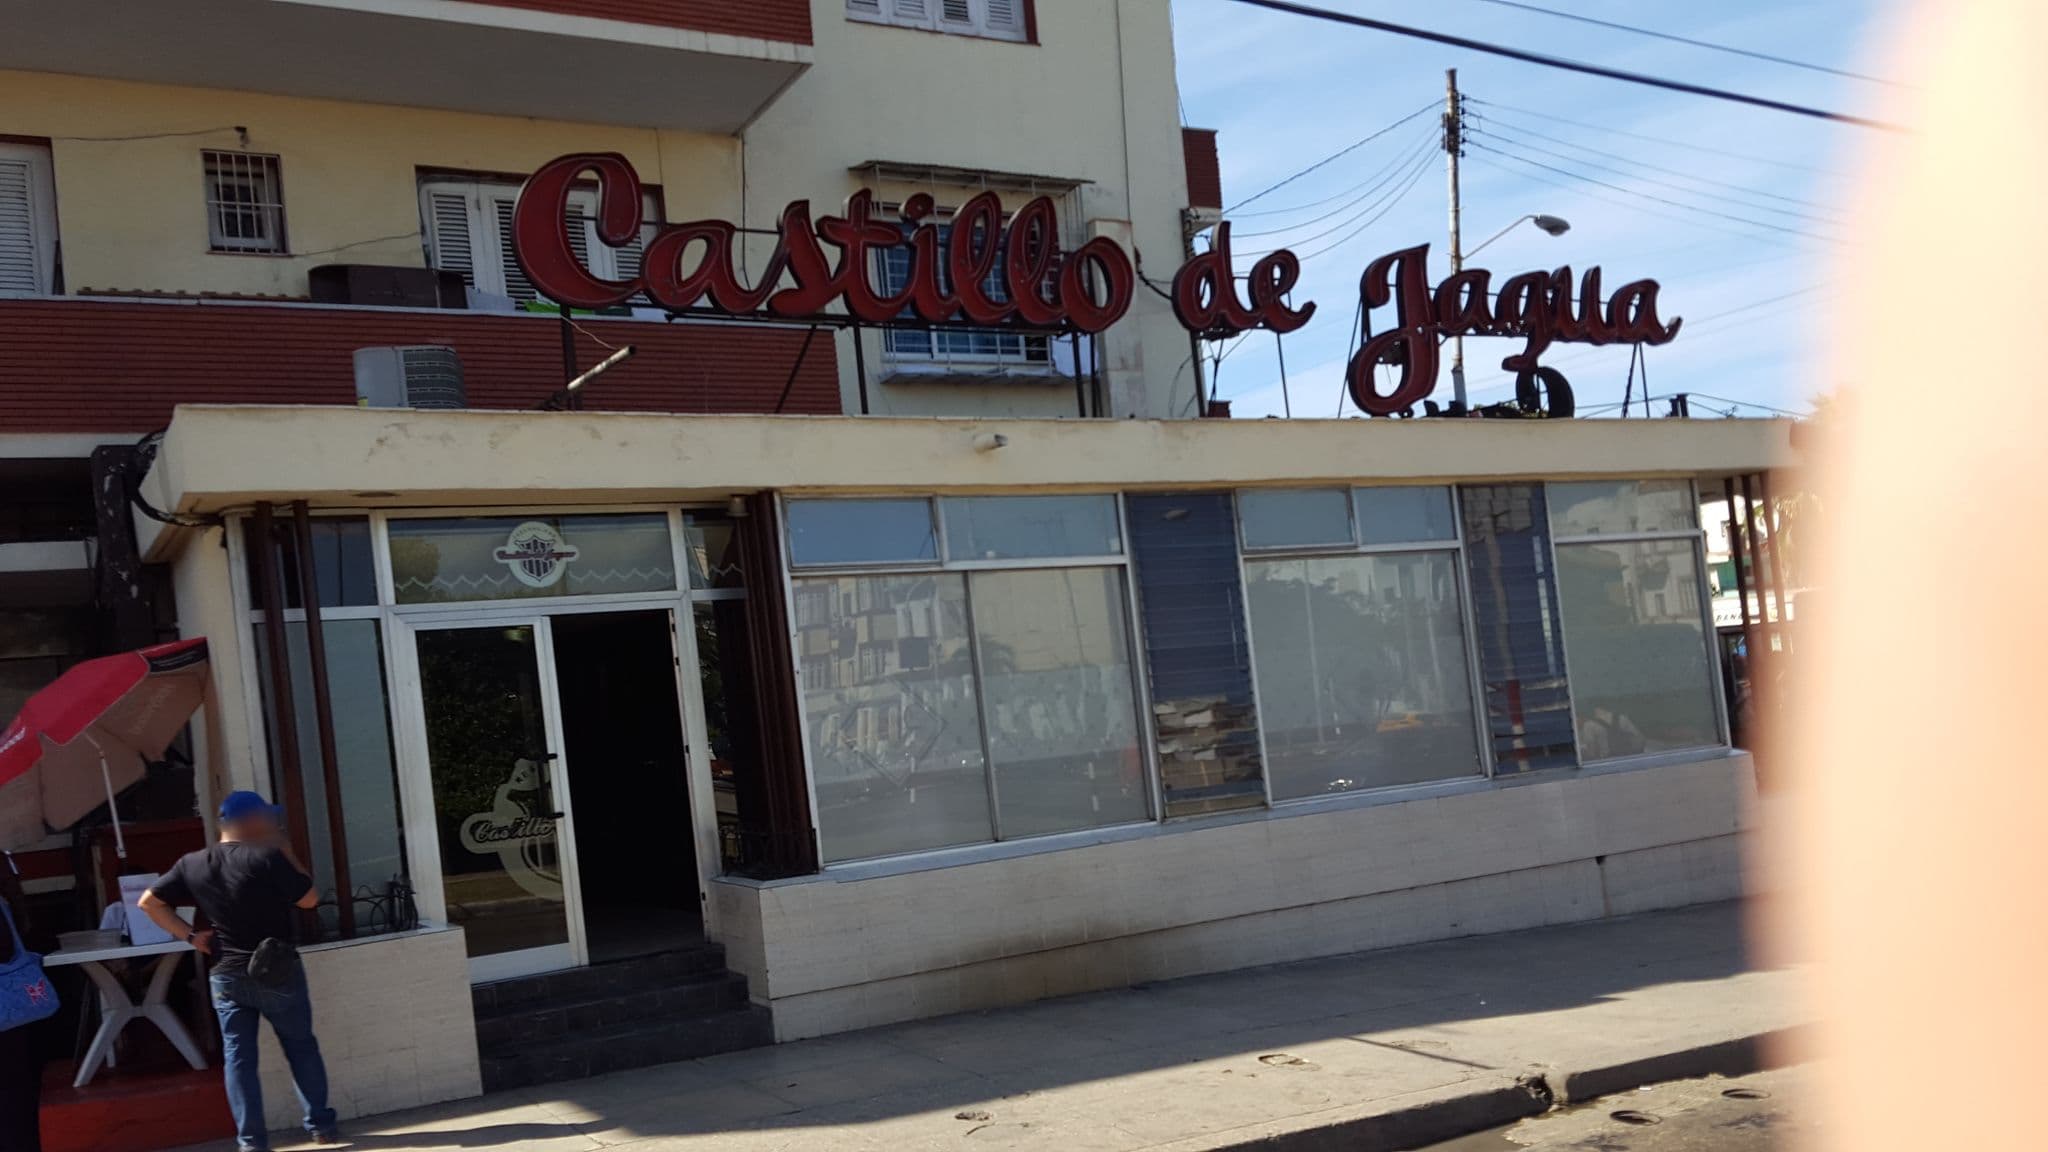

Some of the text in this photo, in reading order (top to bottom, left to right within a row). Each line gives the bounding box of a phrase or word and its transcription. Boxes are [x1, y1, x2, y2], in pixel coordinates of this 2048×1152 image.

[511, 152, 1683, 418] Castillo de Jagua
